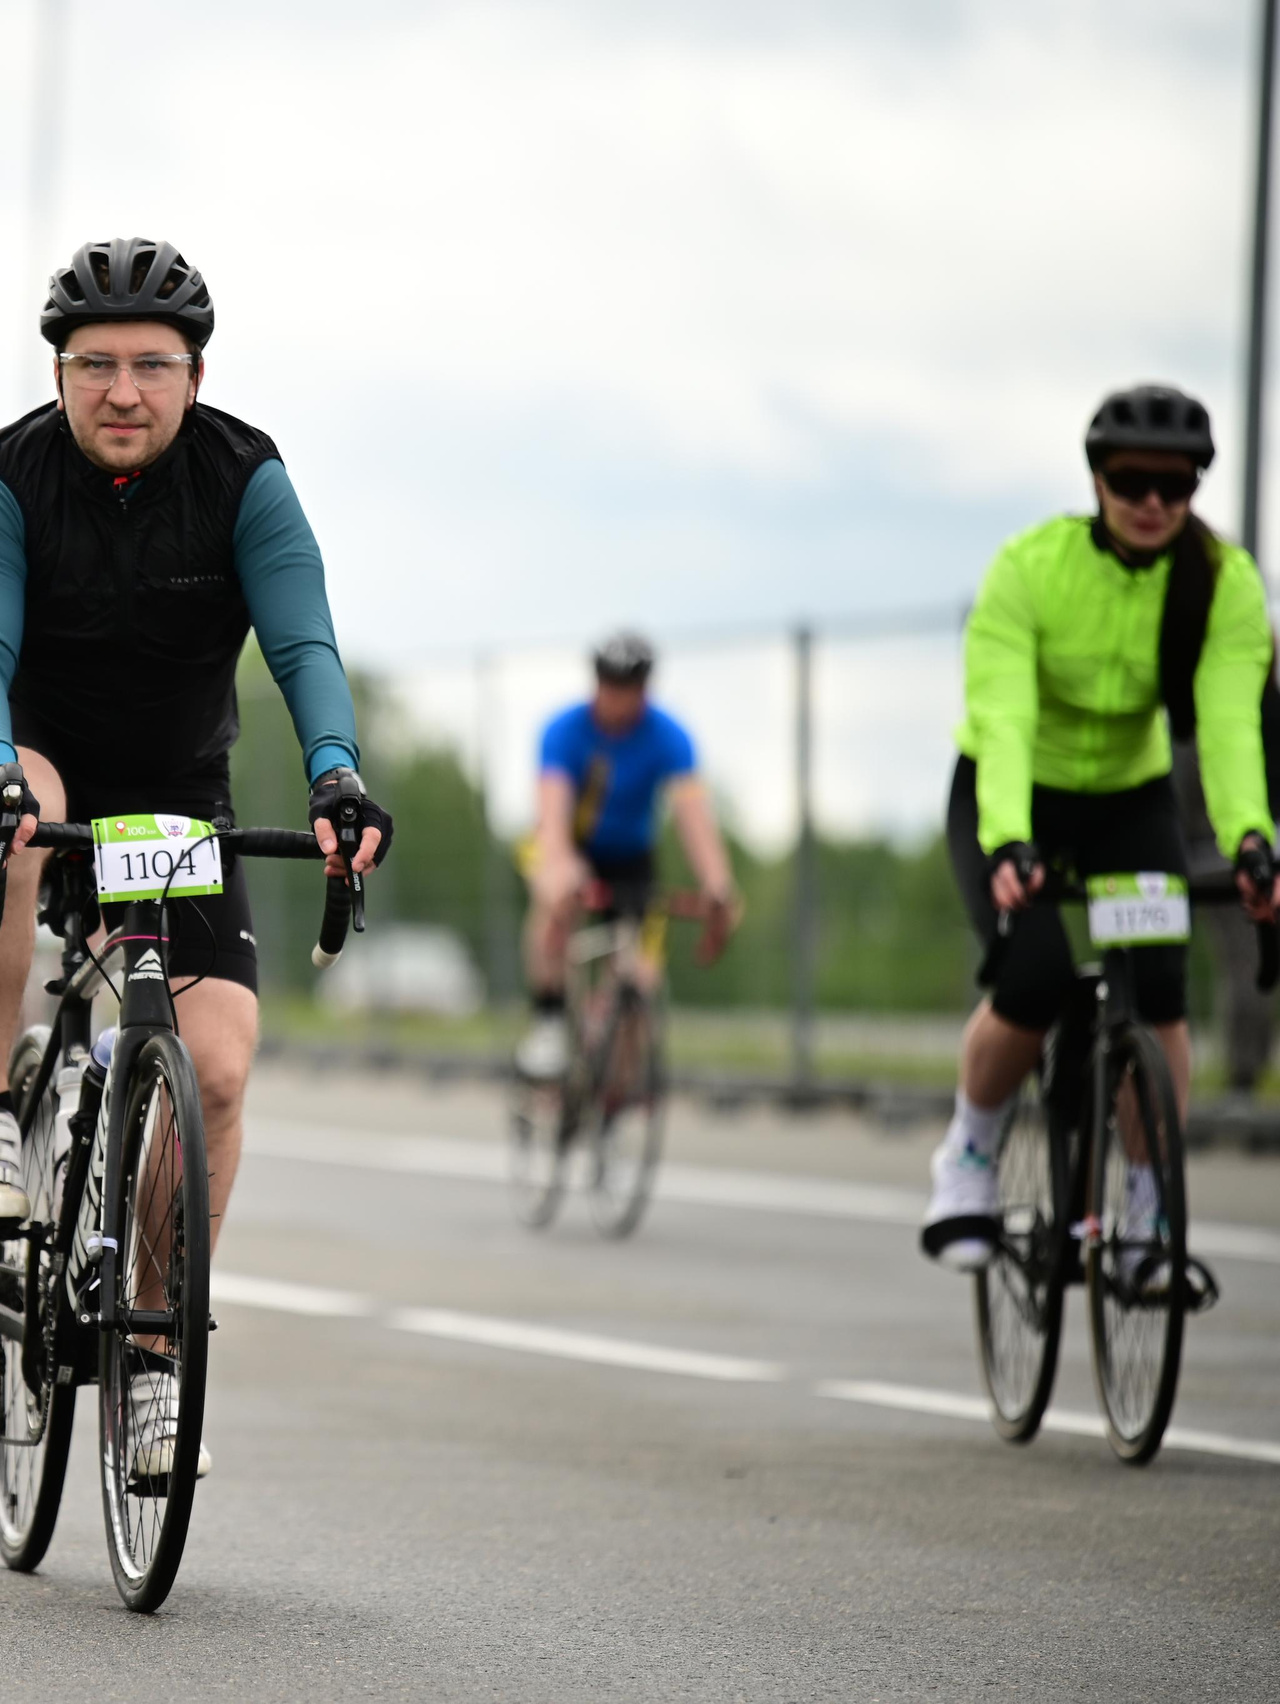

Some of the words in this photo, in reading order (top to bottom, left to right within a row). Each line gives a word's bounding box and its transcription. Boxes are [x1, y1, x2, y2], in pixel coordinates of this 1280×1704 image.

[127, 826, 146, 837] 100
[120, 849, 197, 881] 1104
[127, 971, 165, 982] MERID
